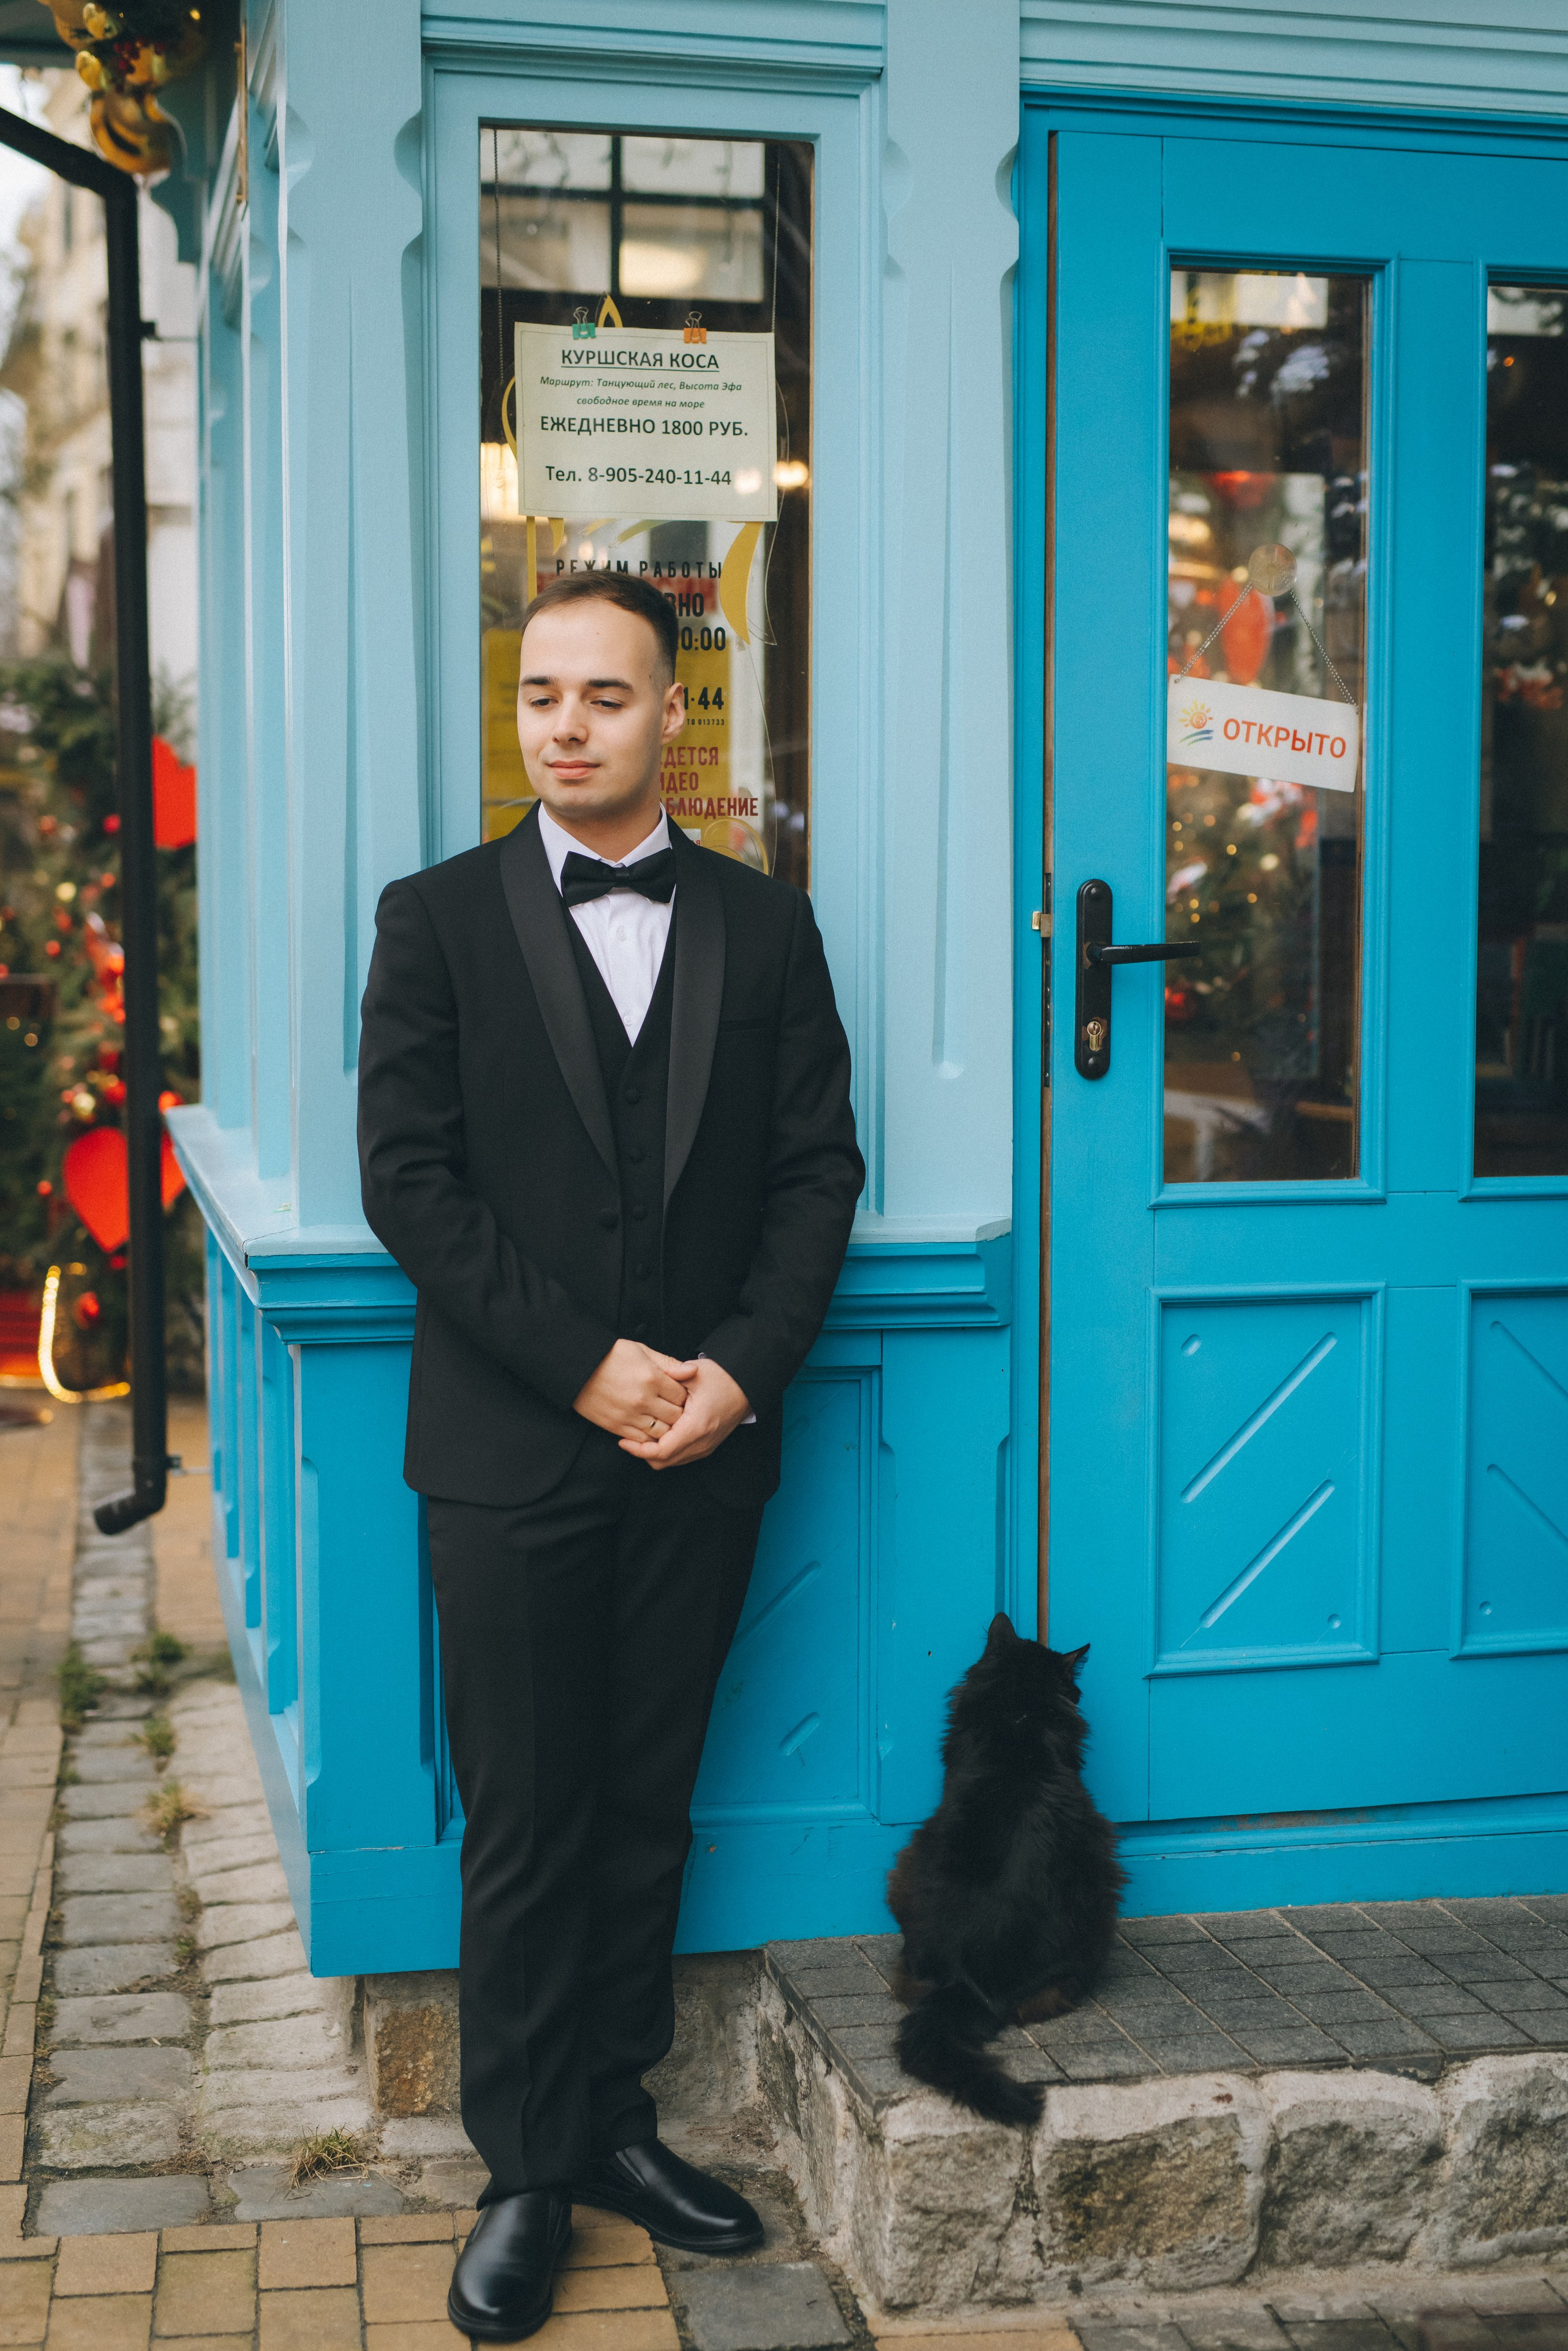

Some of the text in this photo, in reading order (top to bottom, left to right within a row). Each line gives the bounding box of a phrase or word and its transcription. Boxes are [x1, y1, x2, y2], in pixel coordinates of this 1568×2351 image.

[562, 350, 720, 369] КУРШСКАЯ КОСА
[540, 376, 742, 392] Маршрут: Танцующий лес, Высота Эфа
[577, 396, 630, 406] свободное
[632, 398, 662, 407] время
[679, 401, 705, 410] море
[541, 415, 748, 436] ЕЖЕДНЕВНО 1800 РУБ.
[546, 466, 731, 485] Тел. 8-905-240-11-44
[639, 560, 721, 578] РАБОТЫ
[681, 627, 726, 651] 0:00
[1223, 718, 1347, 759] ОТКРЫТО
[663, 746, 719, 769] ДЕТСЯ
[665, 797, 759, 820] БЛЮДЕНИЕ
